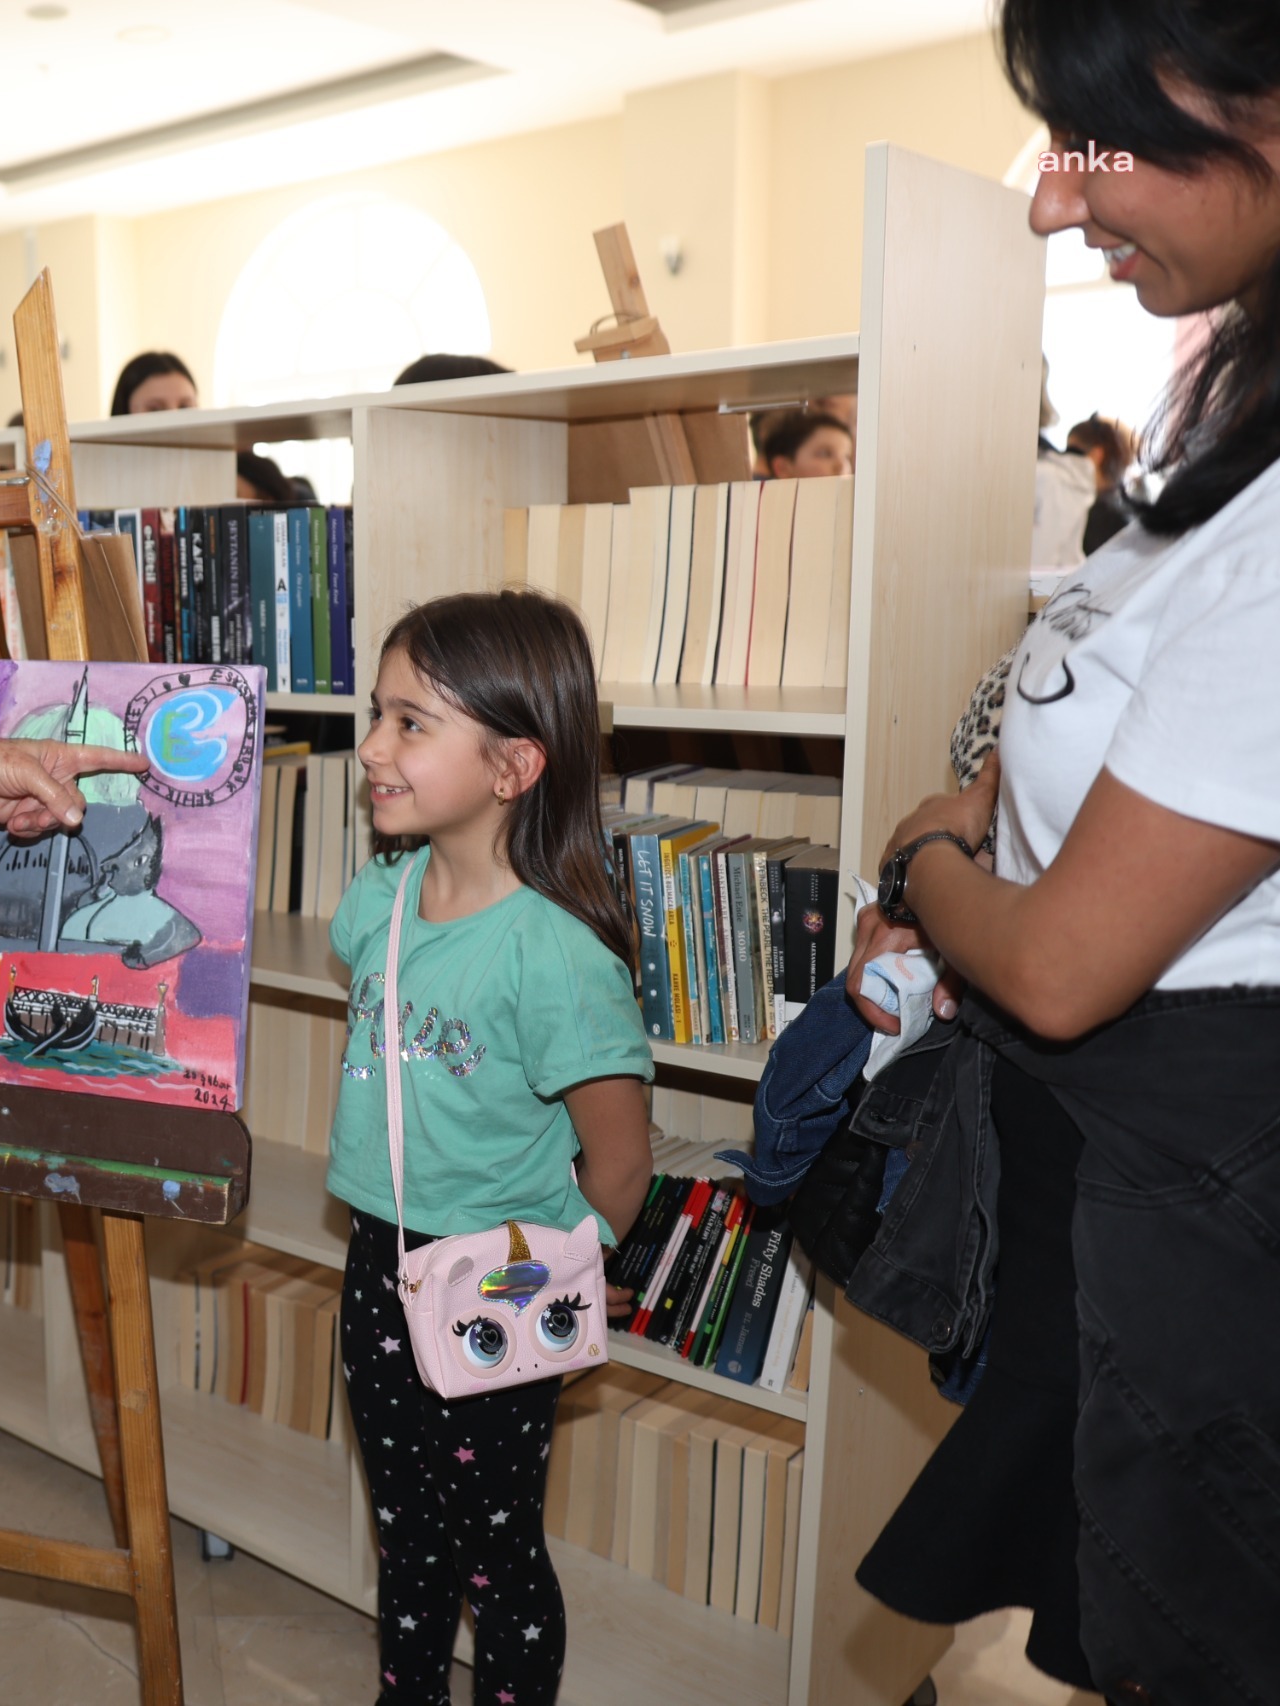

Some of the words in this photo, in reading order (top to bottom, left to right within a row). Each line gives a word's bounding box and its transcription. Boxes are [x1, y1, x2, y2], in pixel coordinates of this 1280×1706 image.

[191, 532, 204, 583] KAFES
[637, 850, 653, 878] LET
[639, 881, 654, 896] IT
[718, 863, 728, 921] SHAKESPEARE
[733, 866, 744, 900] Michael
[757, 858, 768, 903] STEINBECK
[640, 898, 656, 938] SNOW
[735, 901, 745, 922] Ende
[762, 907, 770, 923] THE
[737, 930, 747, 962] MOMO
[766, 969, 774, 985] RED
[766, 986, 775, 1008] PONY
[762, 1229, 782, 1261] Fifty
[745, 1257, 761, 1288] Freed
[751, 1264, 774, 1309] Shades
[735, 1323, 751, 1356] James
